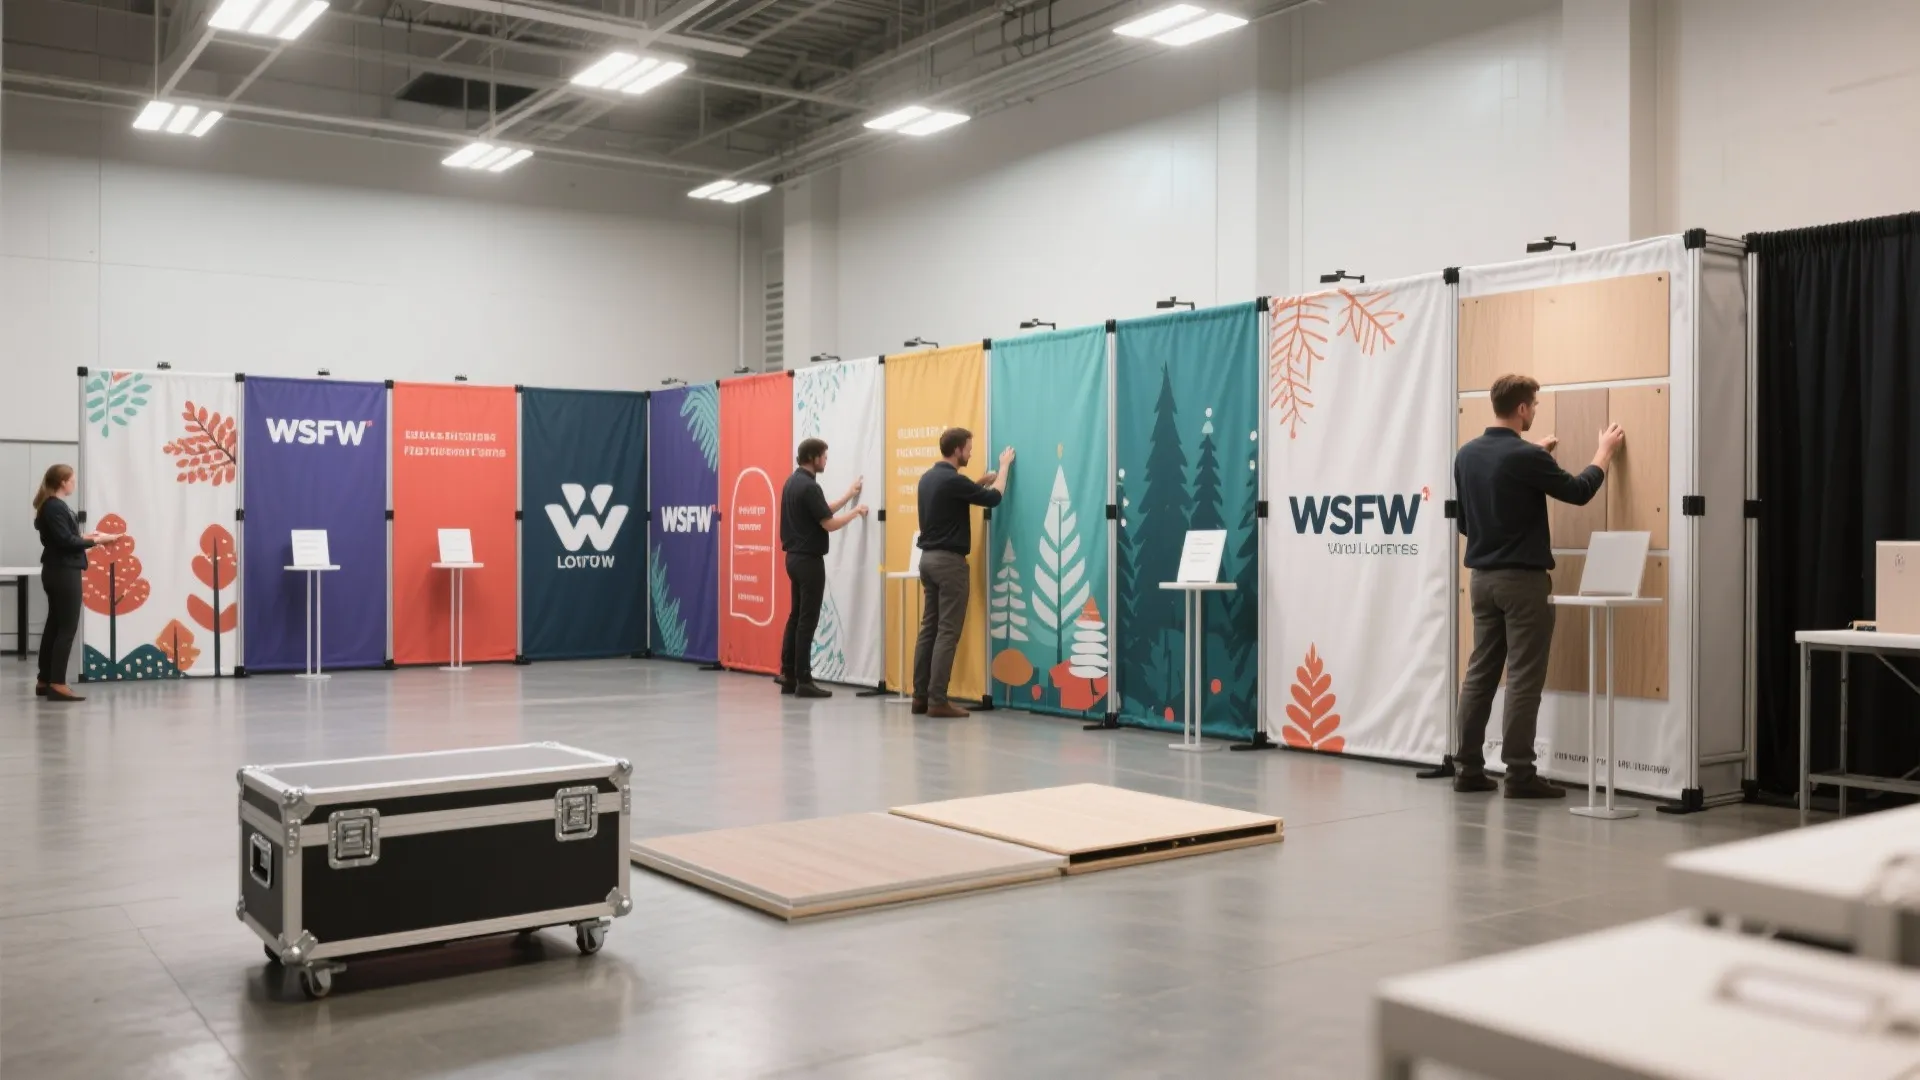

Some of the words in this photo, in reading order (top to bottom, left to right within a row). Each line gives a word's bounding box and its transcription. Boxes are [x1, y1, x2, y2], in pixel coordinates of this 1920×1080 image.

[265, 418, 367, 446] WSFW
[661, 505, 713, 533] WSFW
[1289, 494, 1422, 535] WSFW
